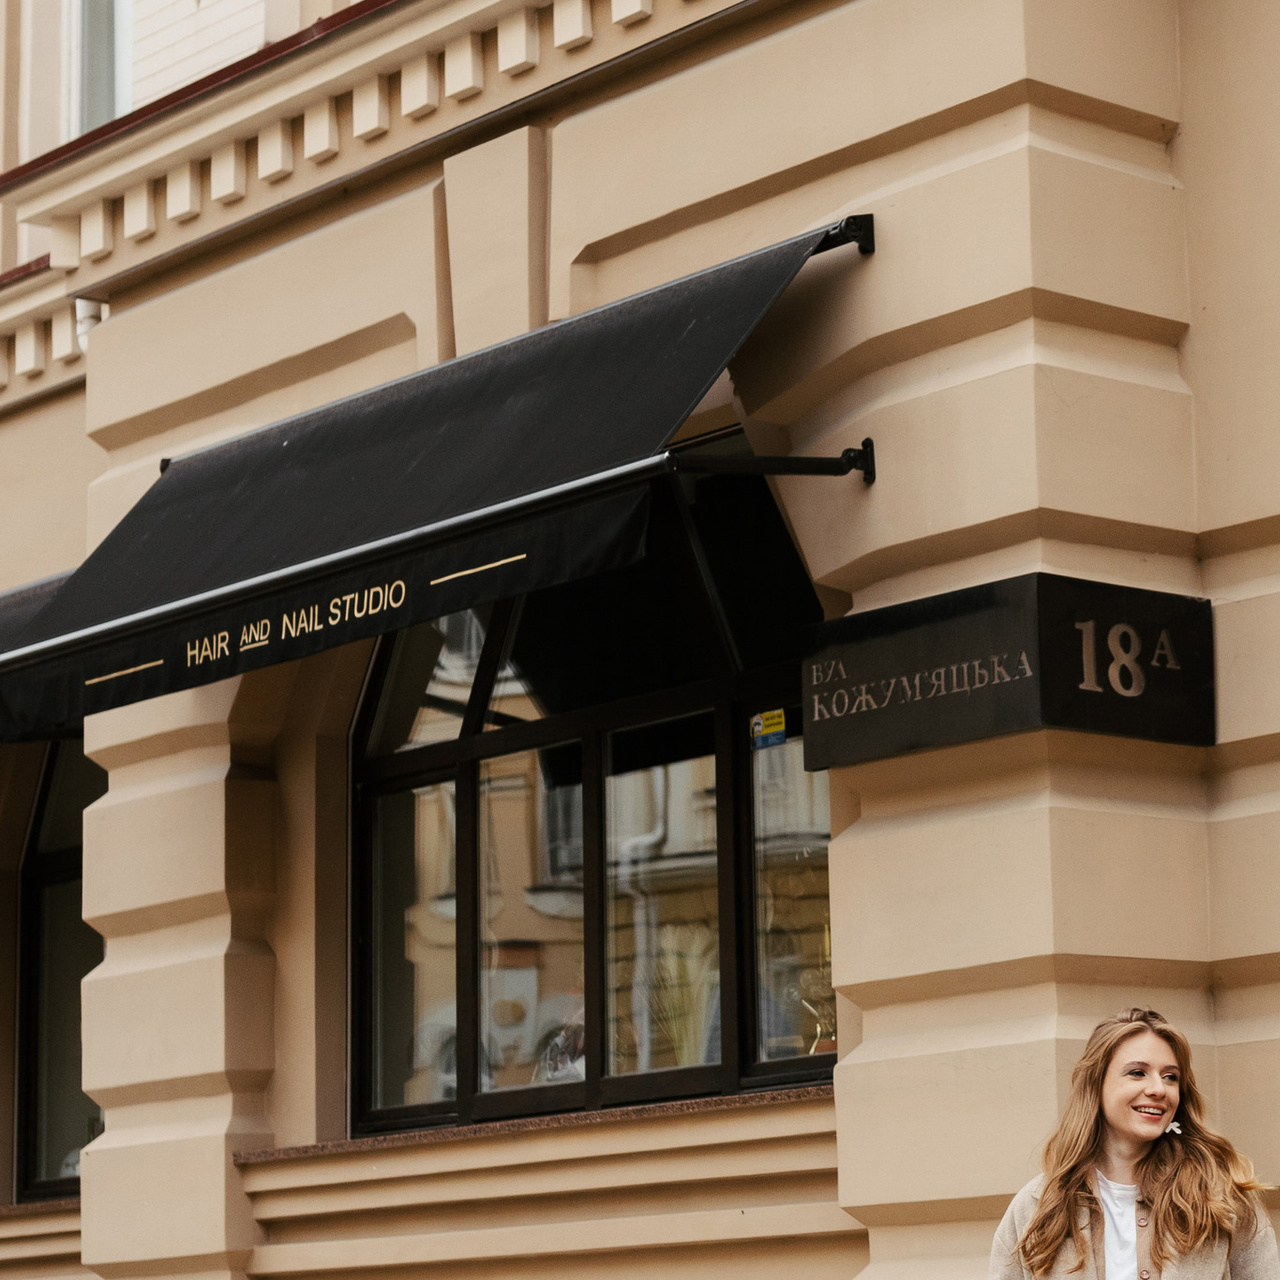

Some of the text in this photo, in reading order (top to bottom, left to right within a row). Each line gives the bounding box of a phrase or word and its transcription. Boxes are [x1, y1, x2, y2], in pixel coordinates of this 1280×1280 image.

[187, 580, 406, 667] HAIR AND NAIL STUDIO
